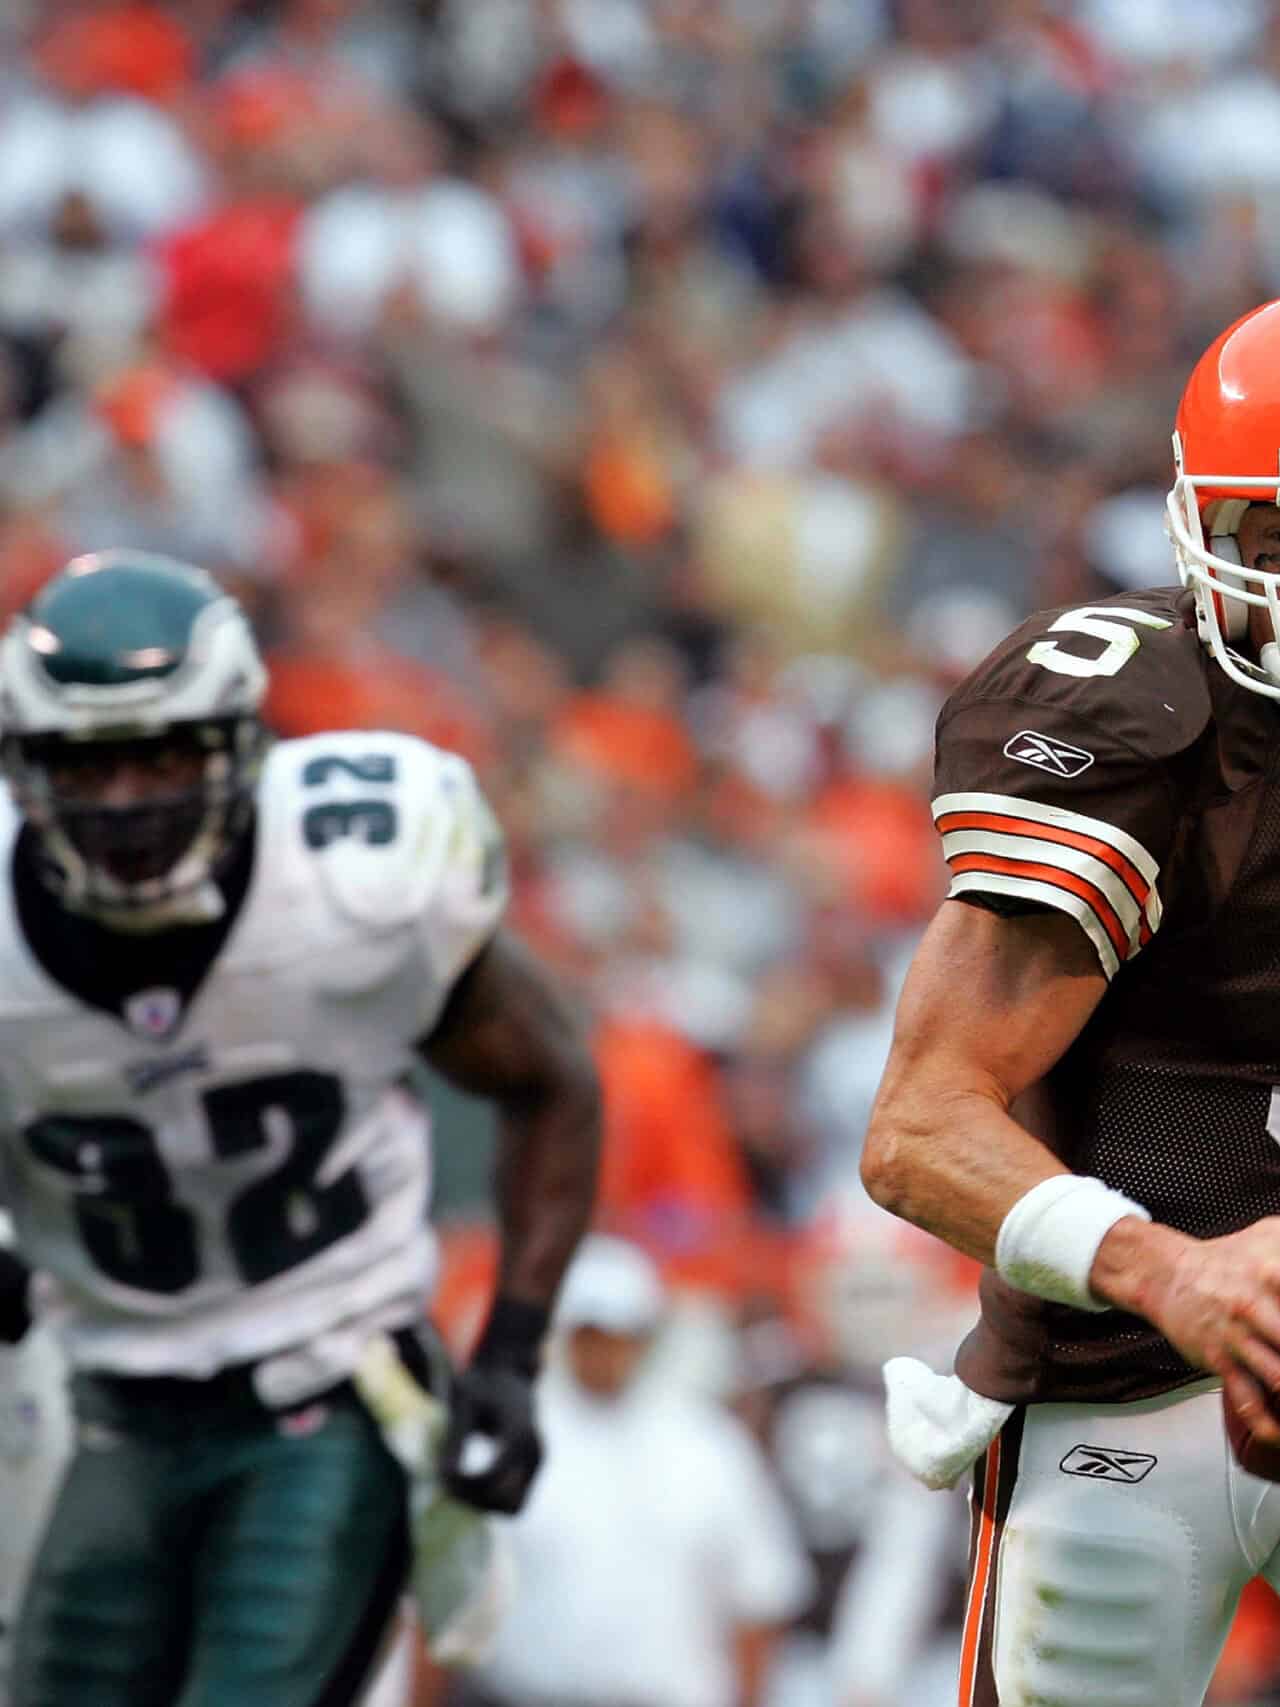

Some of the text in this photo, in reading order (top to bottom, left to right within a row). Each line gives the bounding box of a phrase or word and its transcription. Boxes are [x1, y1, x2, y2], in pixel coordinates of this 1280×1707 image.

[1025, 606, 1174, 678] 5
[302, 754, 397, 850] 32
[24, 1068, 373, 1295] 32
